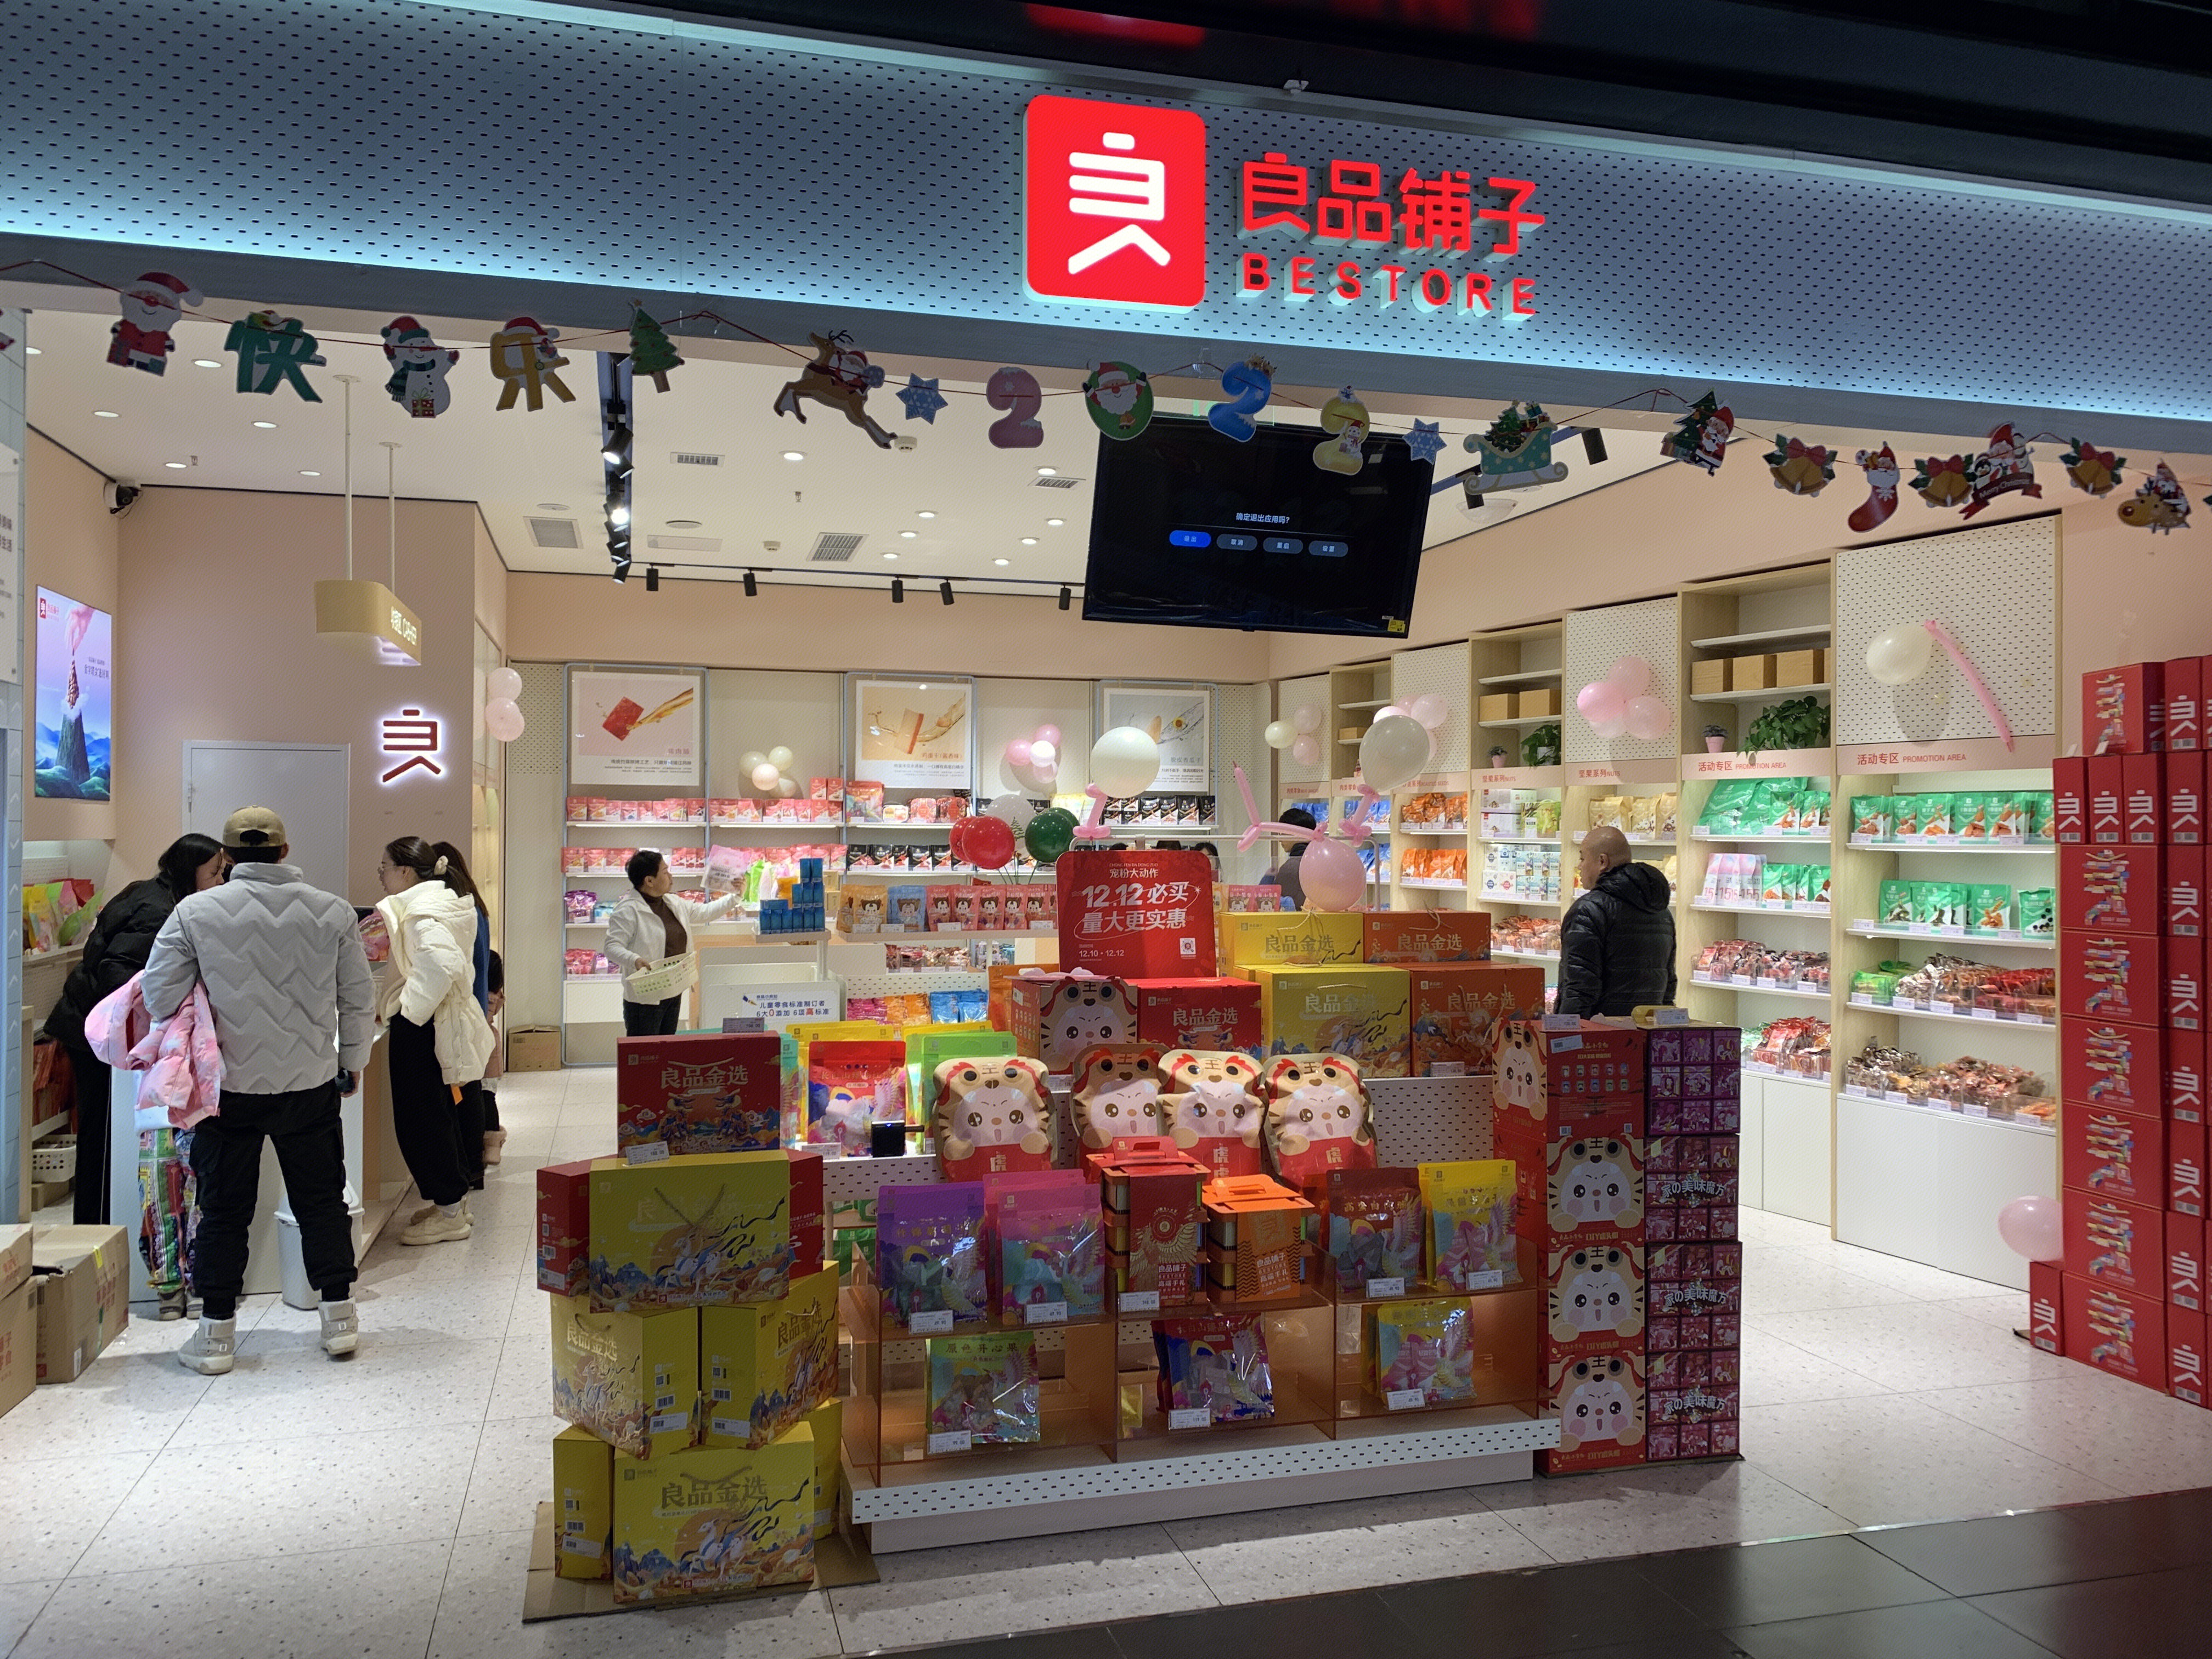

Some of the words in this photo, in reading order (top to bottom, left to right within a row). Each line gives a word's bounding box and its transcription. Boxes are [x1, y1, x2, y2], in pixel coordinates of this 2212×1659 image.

[1242, 153, 1545, 255] 良品铺子
[1242, 253, 1535, 315] BESTORE
[224, 311, 326, 403] 快
[1207, 359, 1273, 443] 2
[1699, 761, 1733, 771] 活动专区
[1858, 753, 1899, 765] 活动专区
[1482, 775, 1505, 783] 坚果系列
[1579, 769, 1606, 778] 坚果系列
[1110, 868, 1159, 878] 宠粉大动作
[1081, 908, 1187, 933] 量大更实惠
[1265, 934, 1334, 953] 良品金选
[1398, 933, 1462, 952] 良品金选
[760, 1000, 825, 1009] 儿童零食标准制订者
[1447, 991, 1516, 1011] 良品金选
[793, 1008, 829, 1016] 6项高标准
[1173, 1007, 1238, 1027] 良品金选
[661, 1065, 749, 1089] 良品金选
[1661, 1180, 1726, 1197] 家の美味魔方
[1159, 1263, 1187, 1273] 良品铺子
[1257, 1252, 1286, 1267] 良品铺子
[1261, 1268, 1288, 1283] 高端手礼
[1664, 1288, 1728, 1307] 家の美味魔方
[1664, 1395, 1726, 1414] 家の美味魔方
[662, 1475, 768, 1510] 良品金选
